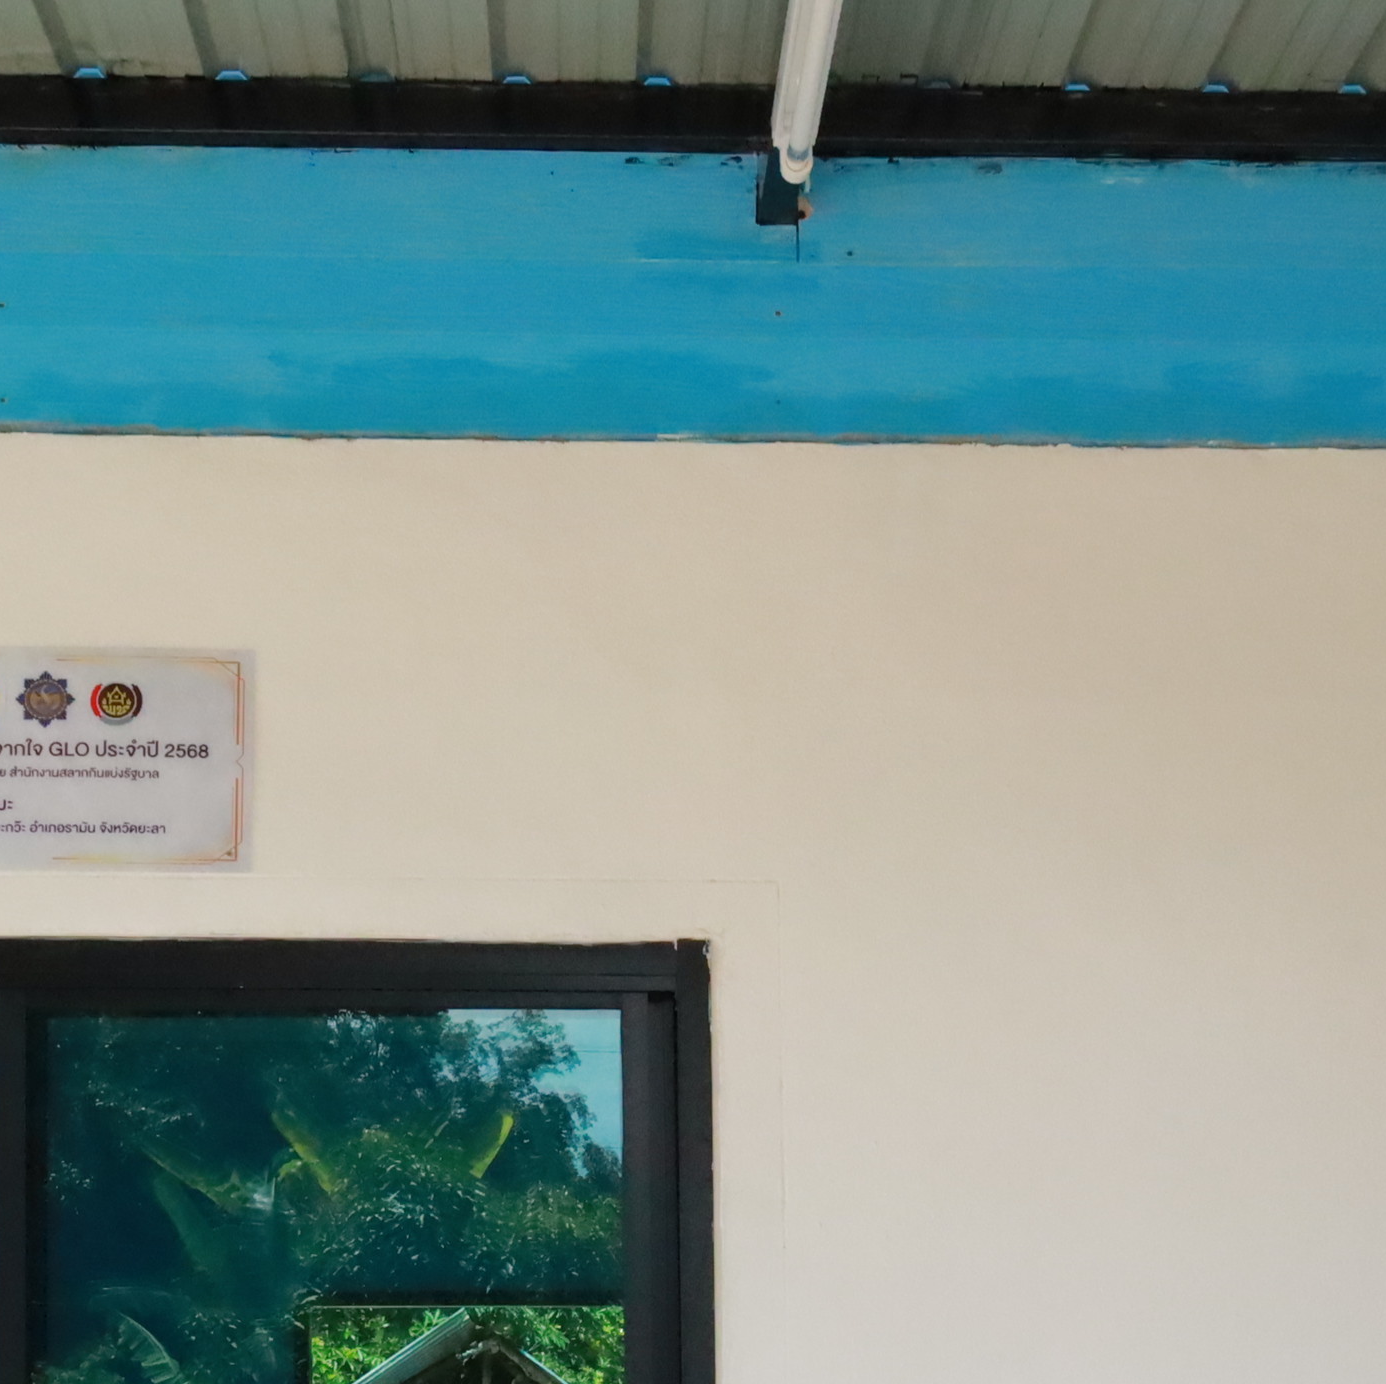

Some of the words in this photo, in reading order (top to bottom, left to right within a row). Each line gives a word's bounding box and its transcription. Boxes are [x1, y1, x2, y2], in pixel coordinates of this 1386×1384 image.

[48, 741, 90, 757] GLO
[95, 739, 159, 758] ประจำปี
[164, 743, 209, 759] 2568
[9, 766, 160, 781] สำนักงานสลากกินแบ่งรัฐบาล
[29, 820, 96, 834] อำเภอรามัน
[100, 821, 166, 834] จังหวัดยะลา
